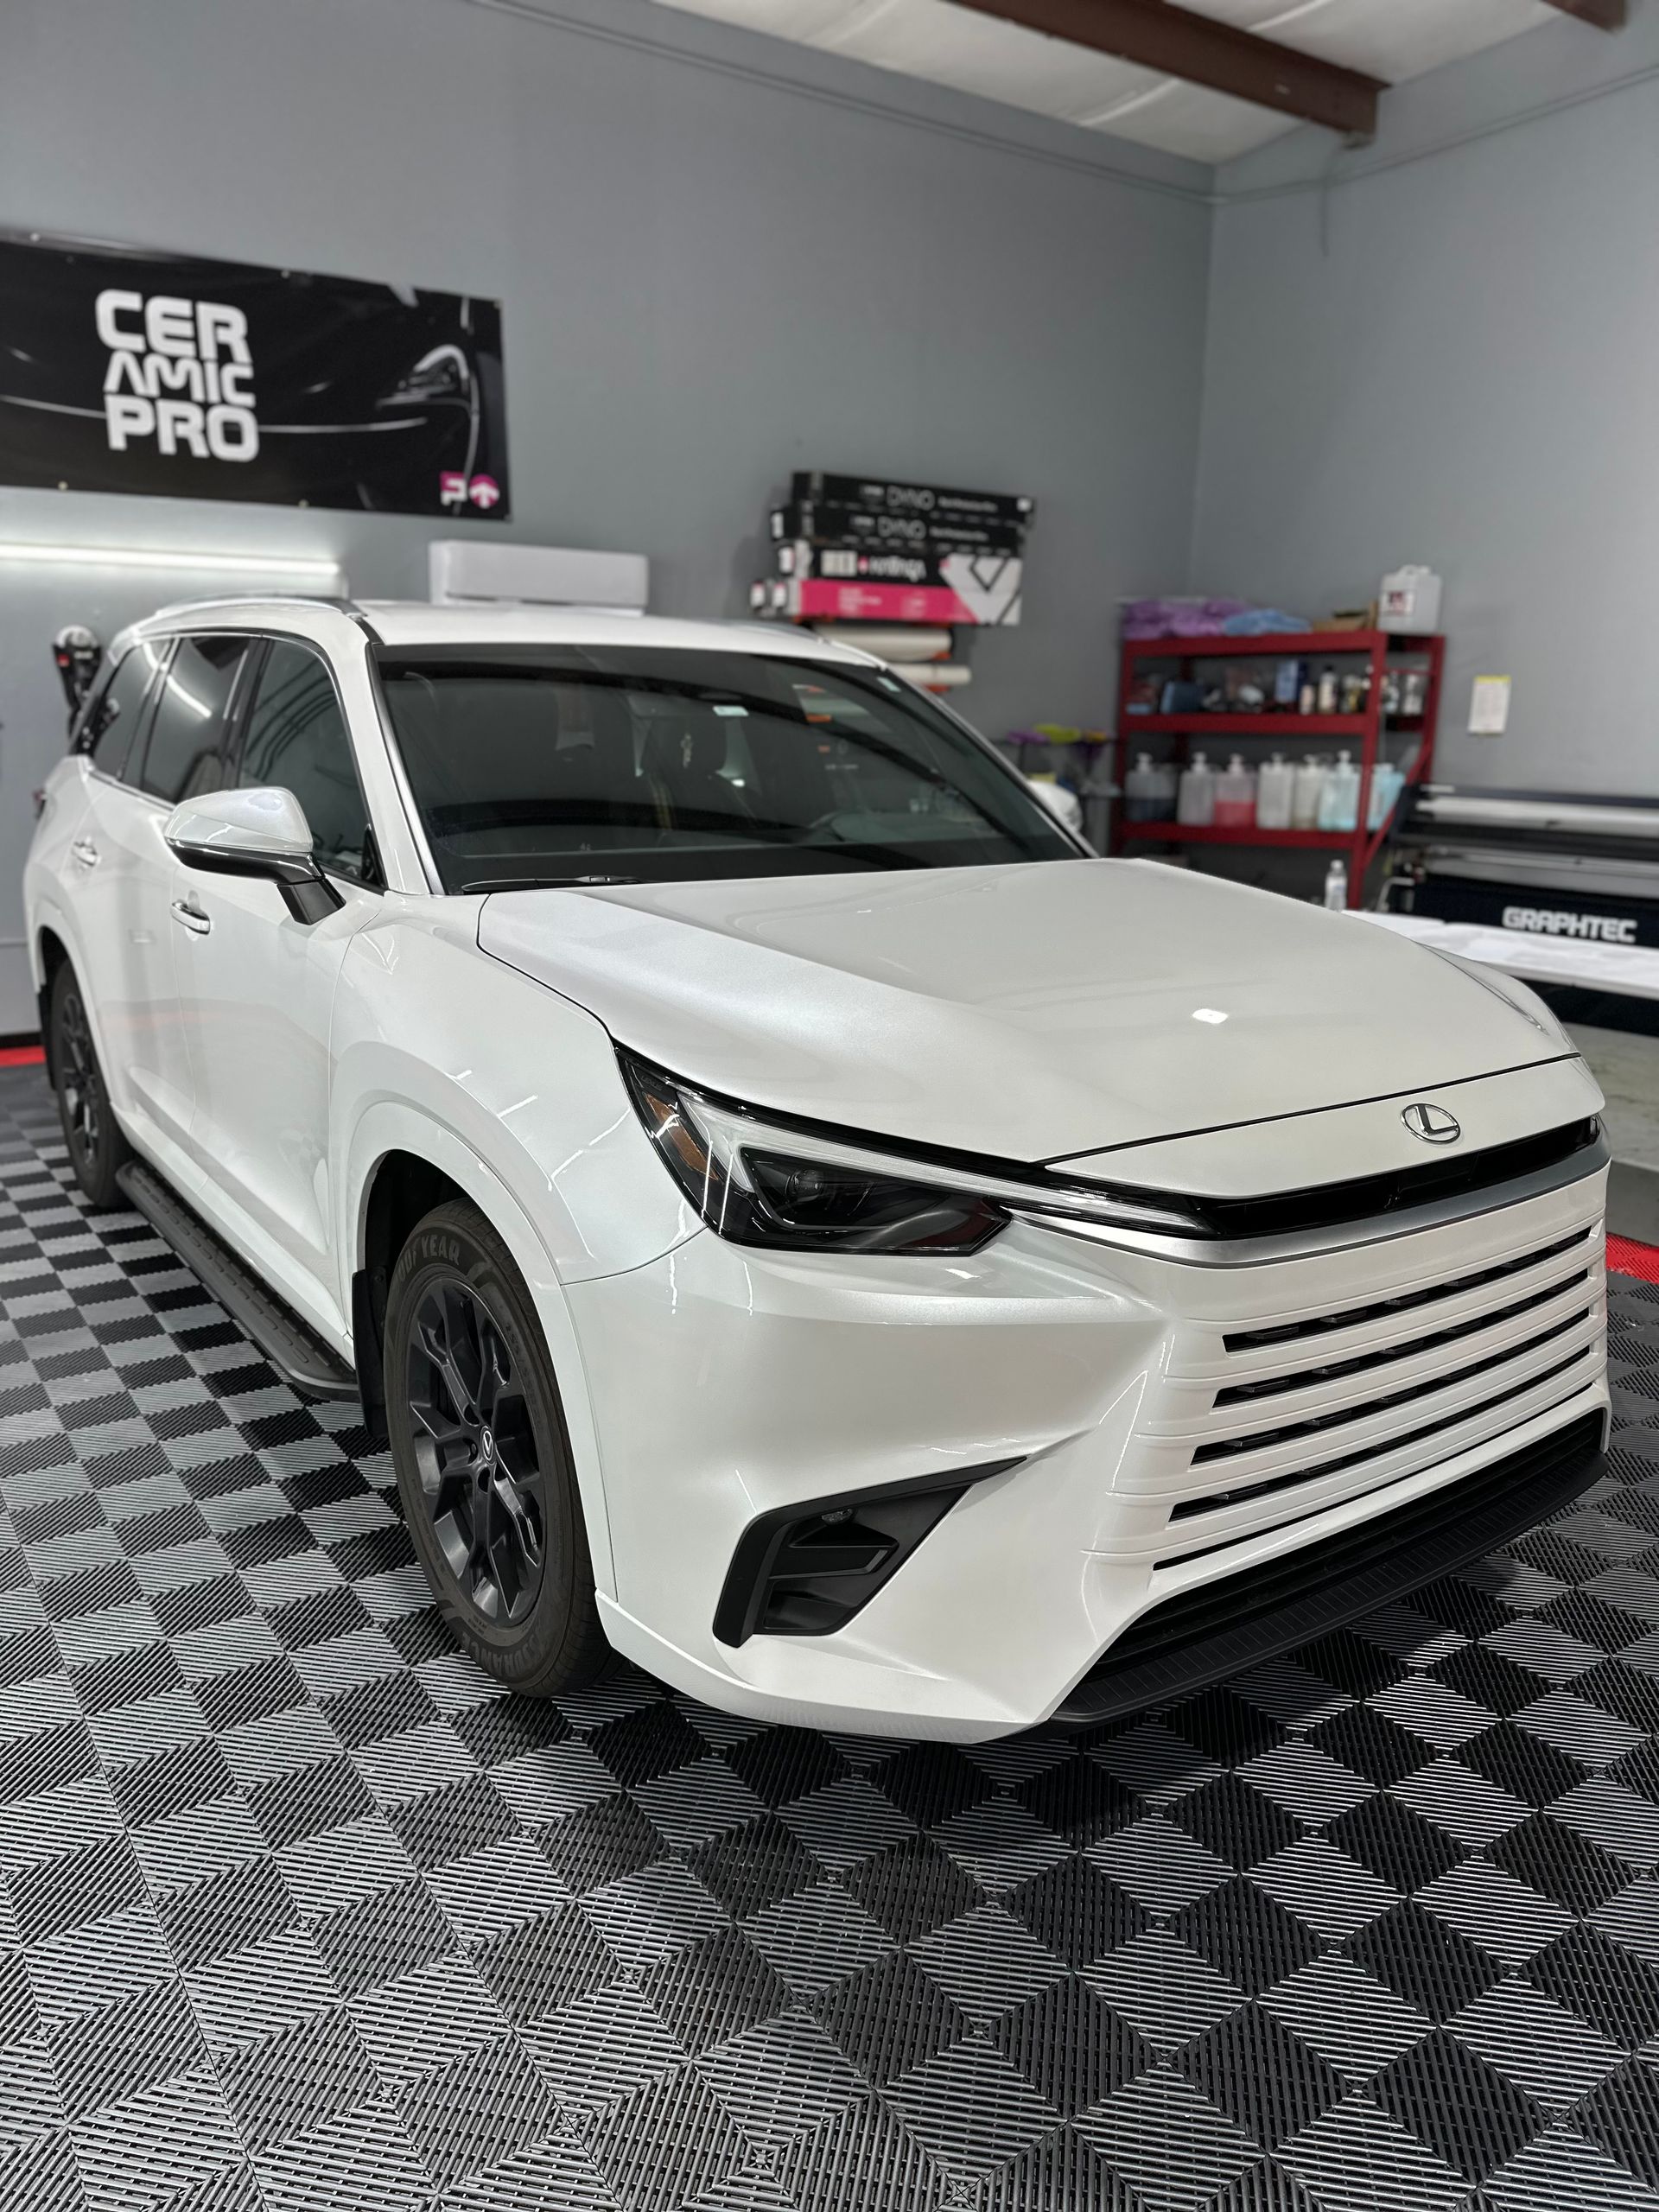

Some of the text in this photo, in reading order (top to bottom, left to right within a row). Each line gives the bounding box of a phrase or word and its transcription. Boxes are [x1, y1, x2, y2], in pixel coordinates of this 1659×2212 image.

[95, 289, 253, 364] CER
[103, 349, 256, 407] AMIC
[104, 393, 259, 462] PRO
[1503, 906, 1637, 944] GRAPHTEC
